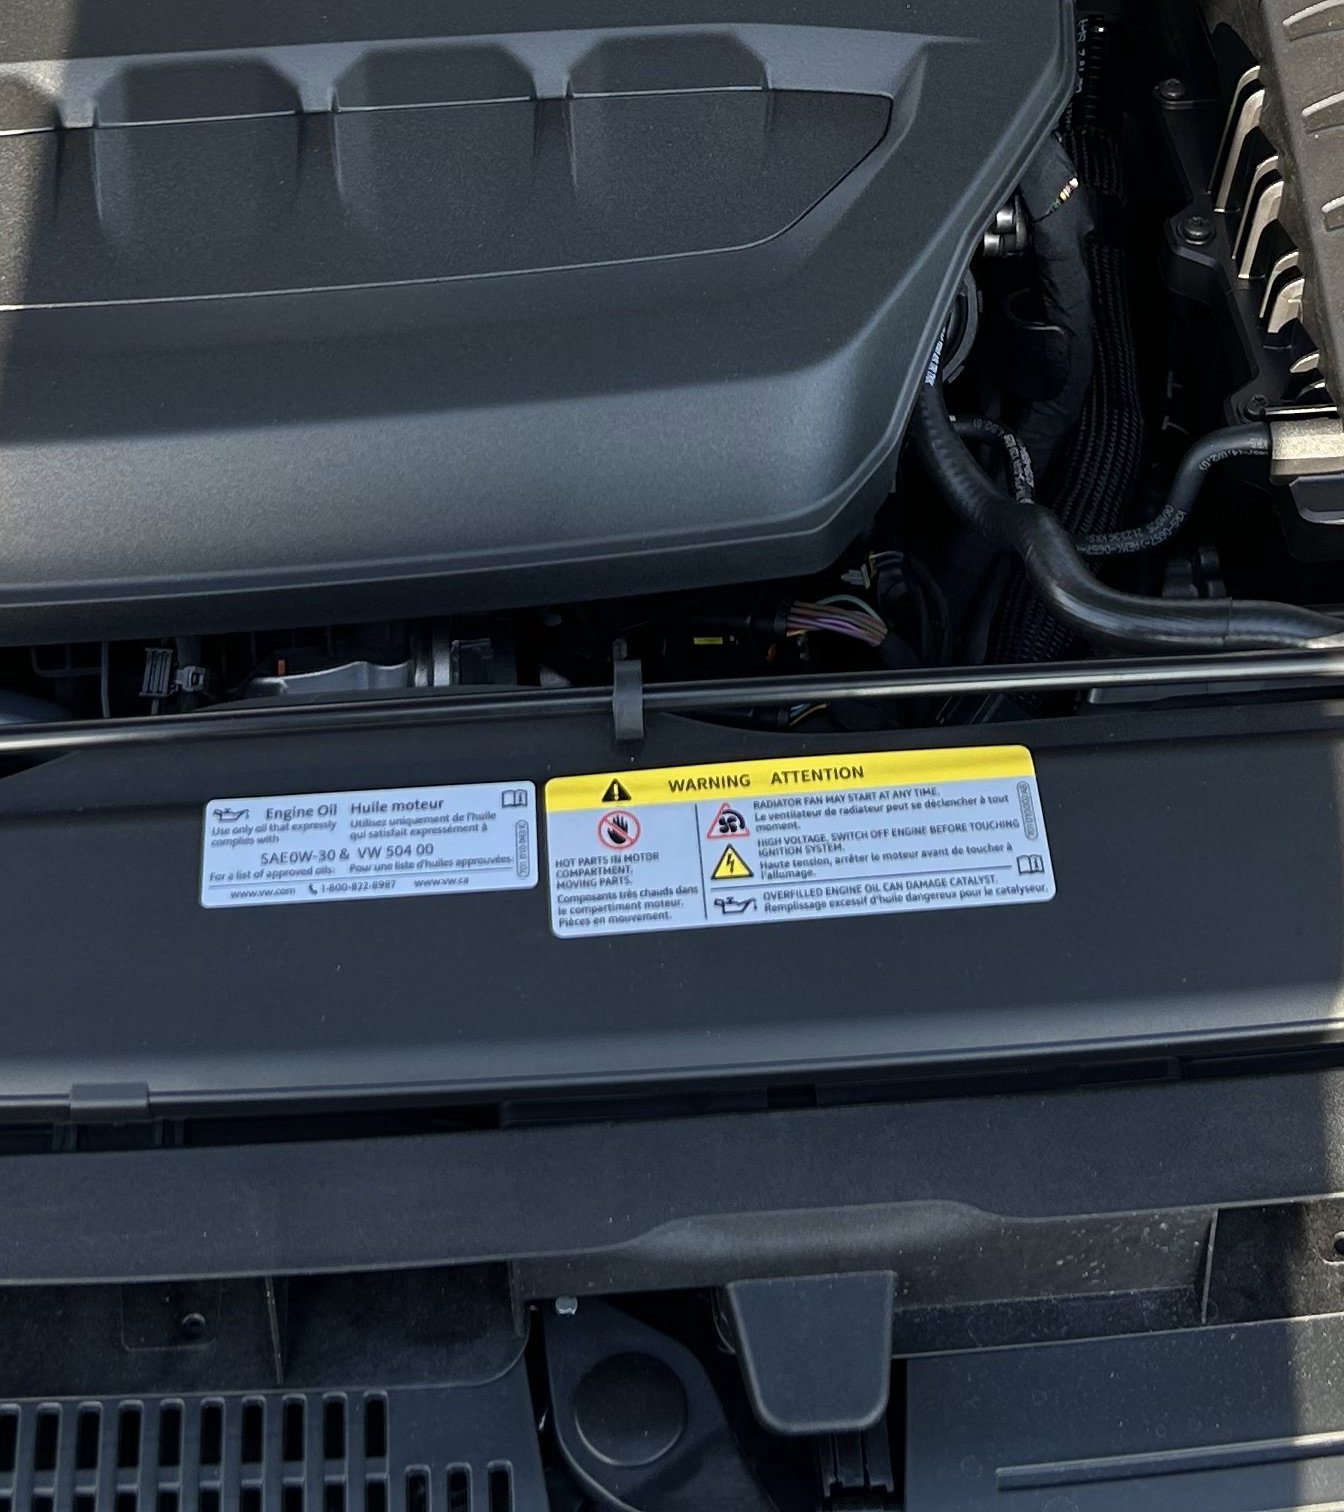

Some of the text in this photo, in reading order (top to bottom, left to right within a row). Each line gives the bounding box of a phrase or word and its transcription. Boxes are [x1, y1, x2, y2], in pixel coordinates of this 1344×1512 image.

[668, 765, 864, 792] WARNING ATTENTION
[266, 799, 444, 821] Engine Oil Huile moteur
[754, 797, 802, 810] RADIATOR
[804, 795, 823, 806] FAN
[826, 794, 845, 804] MAY
[848, 791, 876, 802] START
[879, 791, 890, 800] AT
[893, 789, 912, 799] ANY
[755, 795, 1008, 821] Le ventilateur de radiateur peut se déclencher à tout
[211, 827, 230, 835] Use
[232, 824, 254, 836] only
[255, 823, 267, 833] oil
[270, 821, 289, 832] that
[291, 820, 337, 833] expressly
[350, 817, 387, 828] Utilisez
[389, 814, 450, 827] uniquement
[452, 813, 464, 822] de
[211, 823, 488, 848] complies with qui satisfait expressément à
[758, 838, 782, 847] HIGH
[831, 831, 868, 842] SWITCH
[870, 829, 889, 839] OFF
[892, 826, 927, 837] ENGINE
[930, 822, 968, 834] BEFORE
[970, 819, 1020, 831] TOUCHING
[339, 848, 349, 860] &
[358, 846, 382, 859] VW
[386, 844, 412, 858] 504
[416, 843, 434, 855] 00
[556, 852, 659, 868] HOT PARTS IN MOTOR
[758, 846, 803, 857] IGNITION
[760, 860, 790, 870] Haute
[872, 851, 880, 861] le
[882, 850, 919, 860] moteur
[921, 847, 949, 858] avant
[952, 846, 964, 856] de
[966, 843, 1004, 854] toucher
[1007, 842, 1013, 851] à
[209, 871, 226, 882] For
[228, 872, 233, 880] a
[236, 870, 251, 880] list
[253, 869, 264, 878] of
[266, 866, 313, 880] approved
[350, 863, 371, 873] Pour
[374, 862, 392, 871] une
[395, 860, 415, 869] liste
[230, 888, 296, 899] www.vw.com
[557, 878, 597, 889] MOVING
[557, 885, 698, 904] Composants très chauds dans
[763, 887, 823, 900] OVERFILLED
[826, 884, 862, 896] ENGINE
[865, 882, 881, 892] OIL
[883, 881, 904, 892] CAN
[906, 877, 948, 889] DAMAGE
[558, 906, 567, 915] le
[570, 902, 642, 916] compartiment
[764, 898, 827, 913] Remplissage
[829, 895, 867, 908] excessif
[906, 889, 957, 902] dangereux
[960, 887, 982, 899] pour
[984, 886, 993, 896] le
[559, 916, 590, 927] Pièces
[593, 916, 606, 925] en
